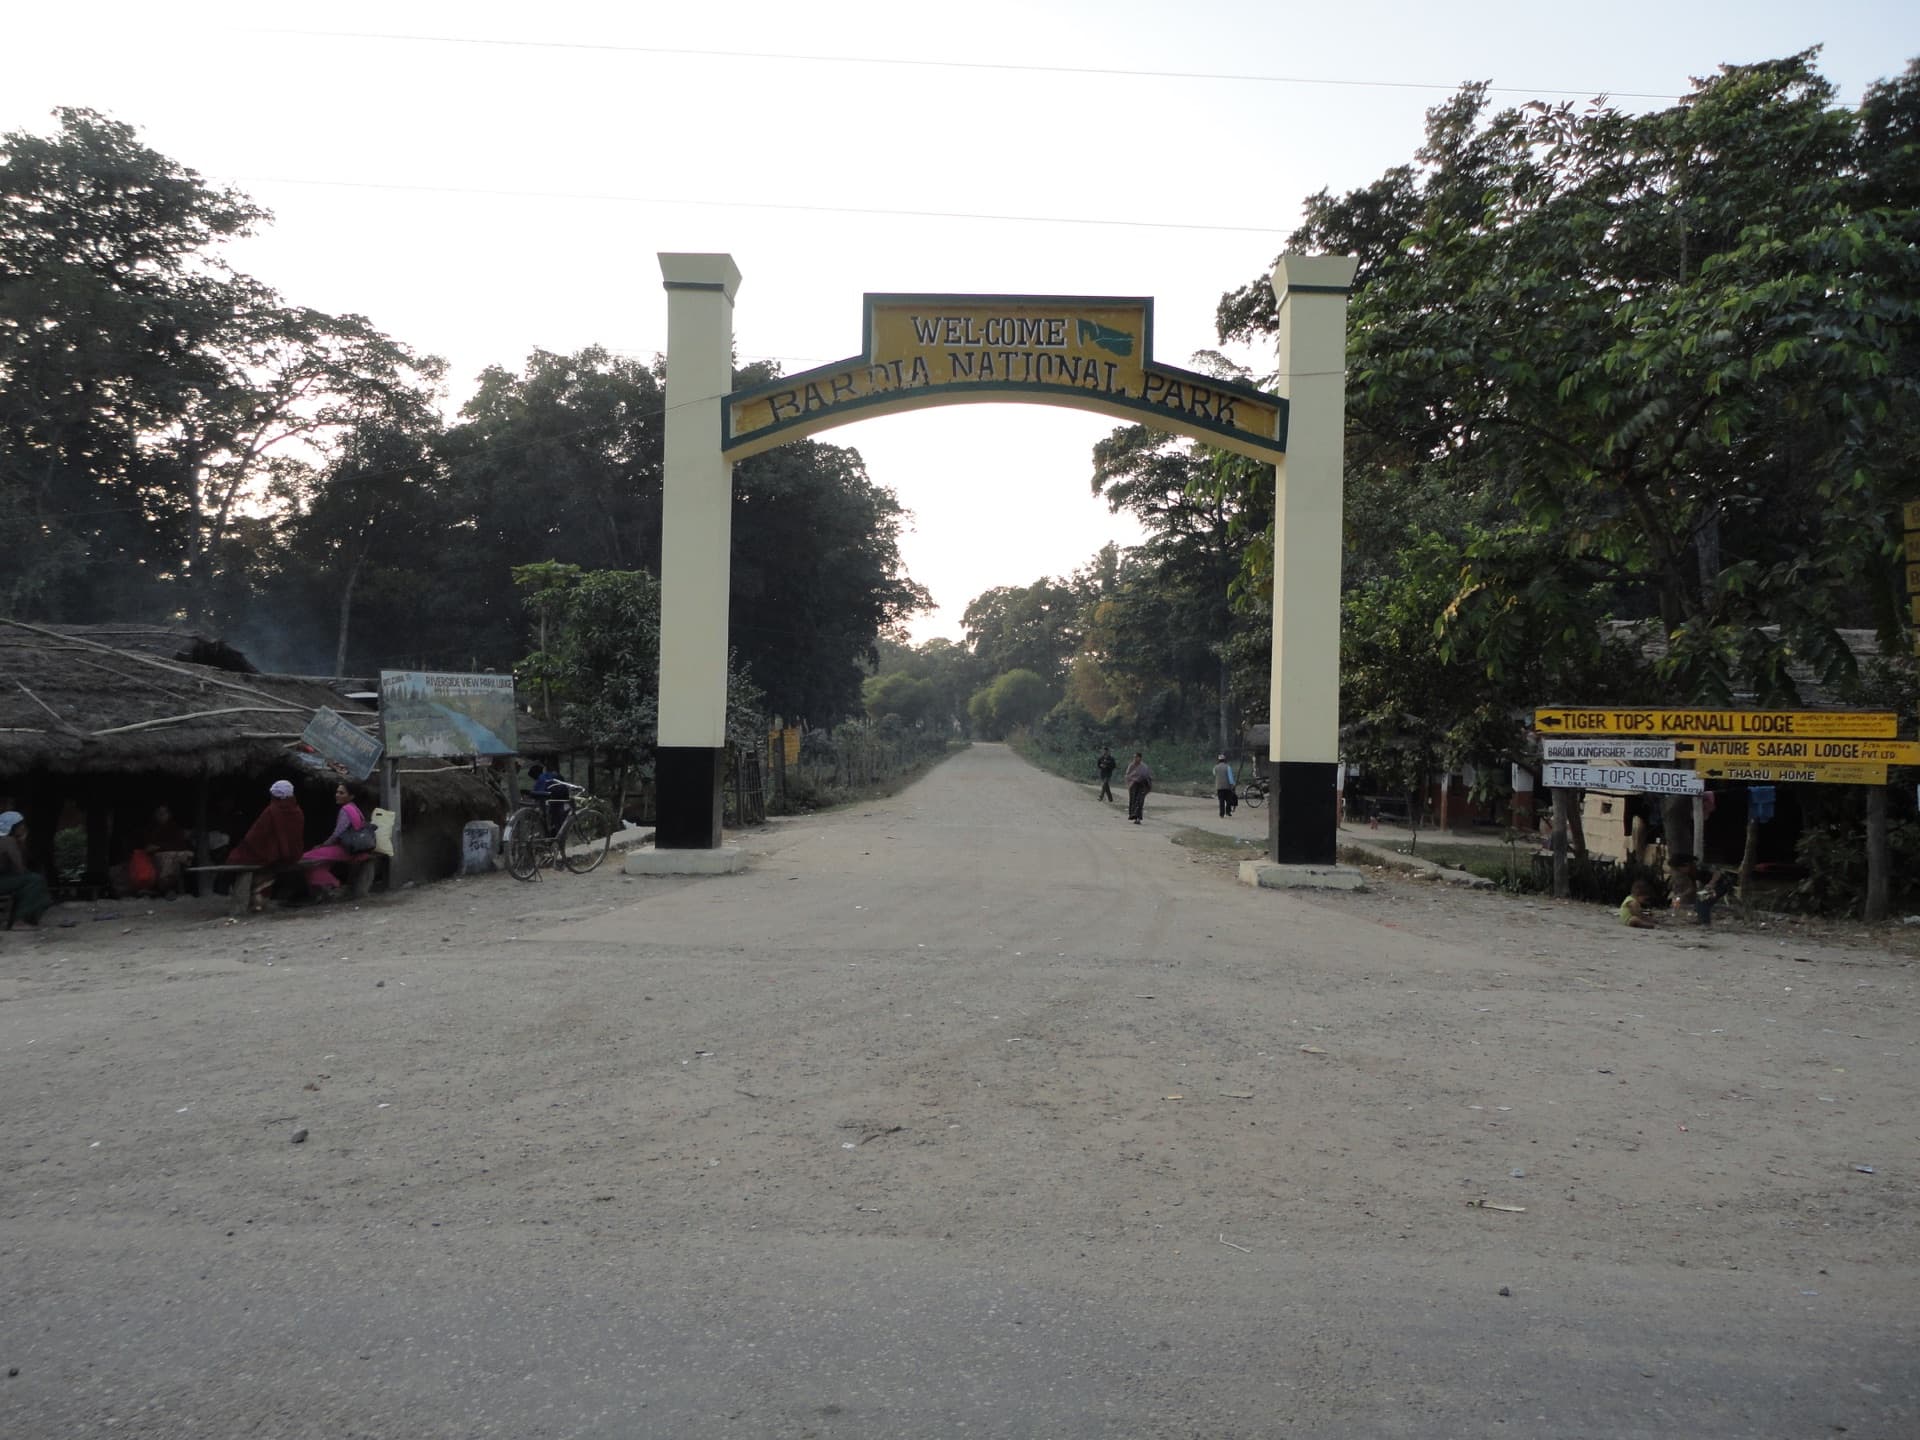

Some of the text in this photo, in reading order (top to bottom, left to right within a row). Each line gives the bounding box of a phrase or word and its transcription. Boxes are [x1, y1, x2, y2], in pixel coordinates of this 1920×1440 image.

[910, 316, 1068, 347] WELCOME
[769, 350, 1240, 427] BARDIA NATIONAL PARK
[1561, 712, 1607, 730] TIGER
[1614, 713, 1655, 731] TOPS
[1661, 713, 1734, 732] KARNALI
[1741, 714, 1794, 733] LODGE
[1699, 741, 1750, 756] NATURE
[1756, 742, 1808, 758] SAFARI
[1814, 743, 1859, 759] LODGE
[1550, 766, 1588, 781] TREE
[1597, 769, 1635, 785] TOPS
[1643, 772, 1688, 788] LODGE
[1727, 768, 1770, 780] THARU
[1779, 770, 1816, 782] HOME
